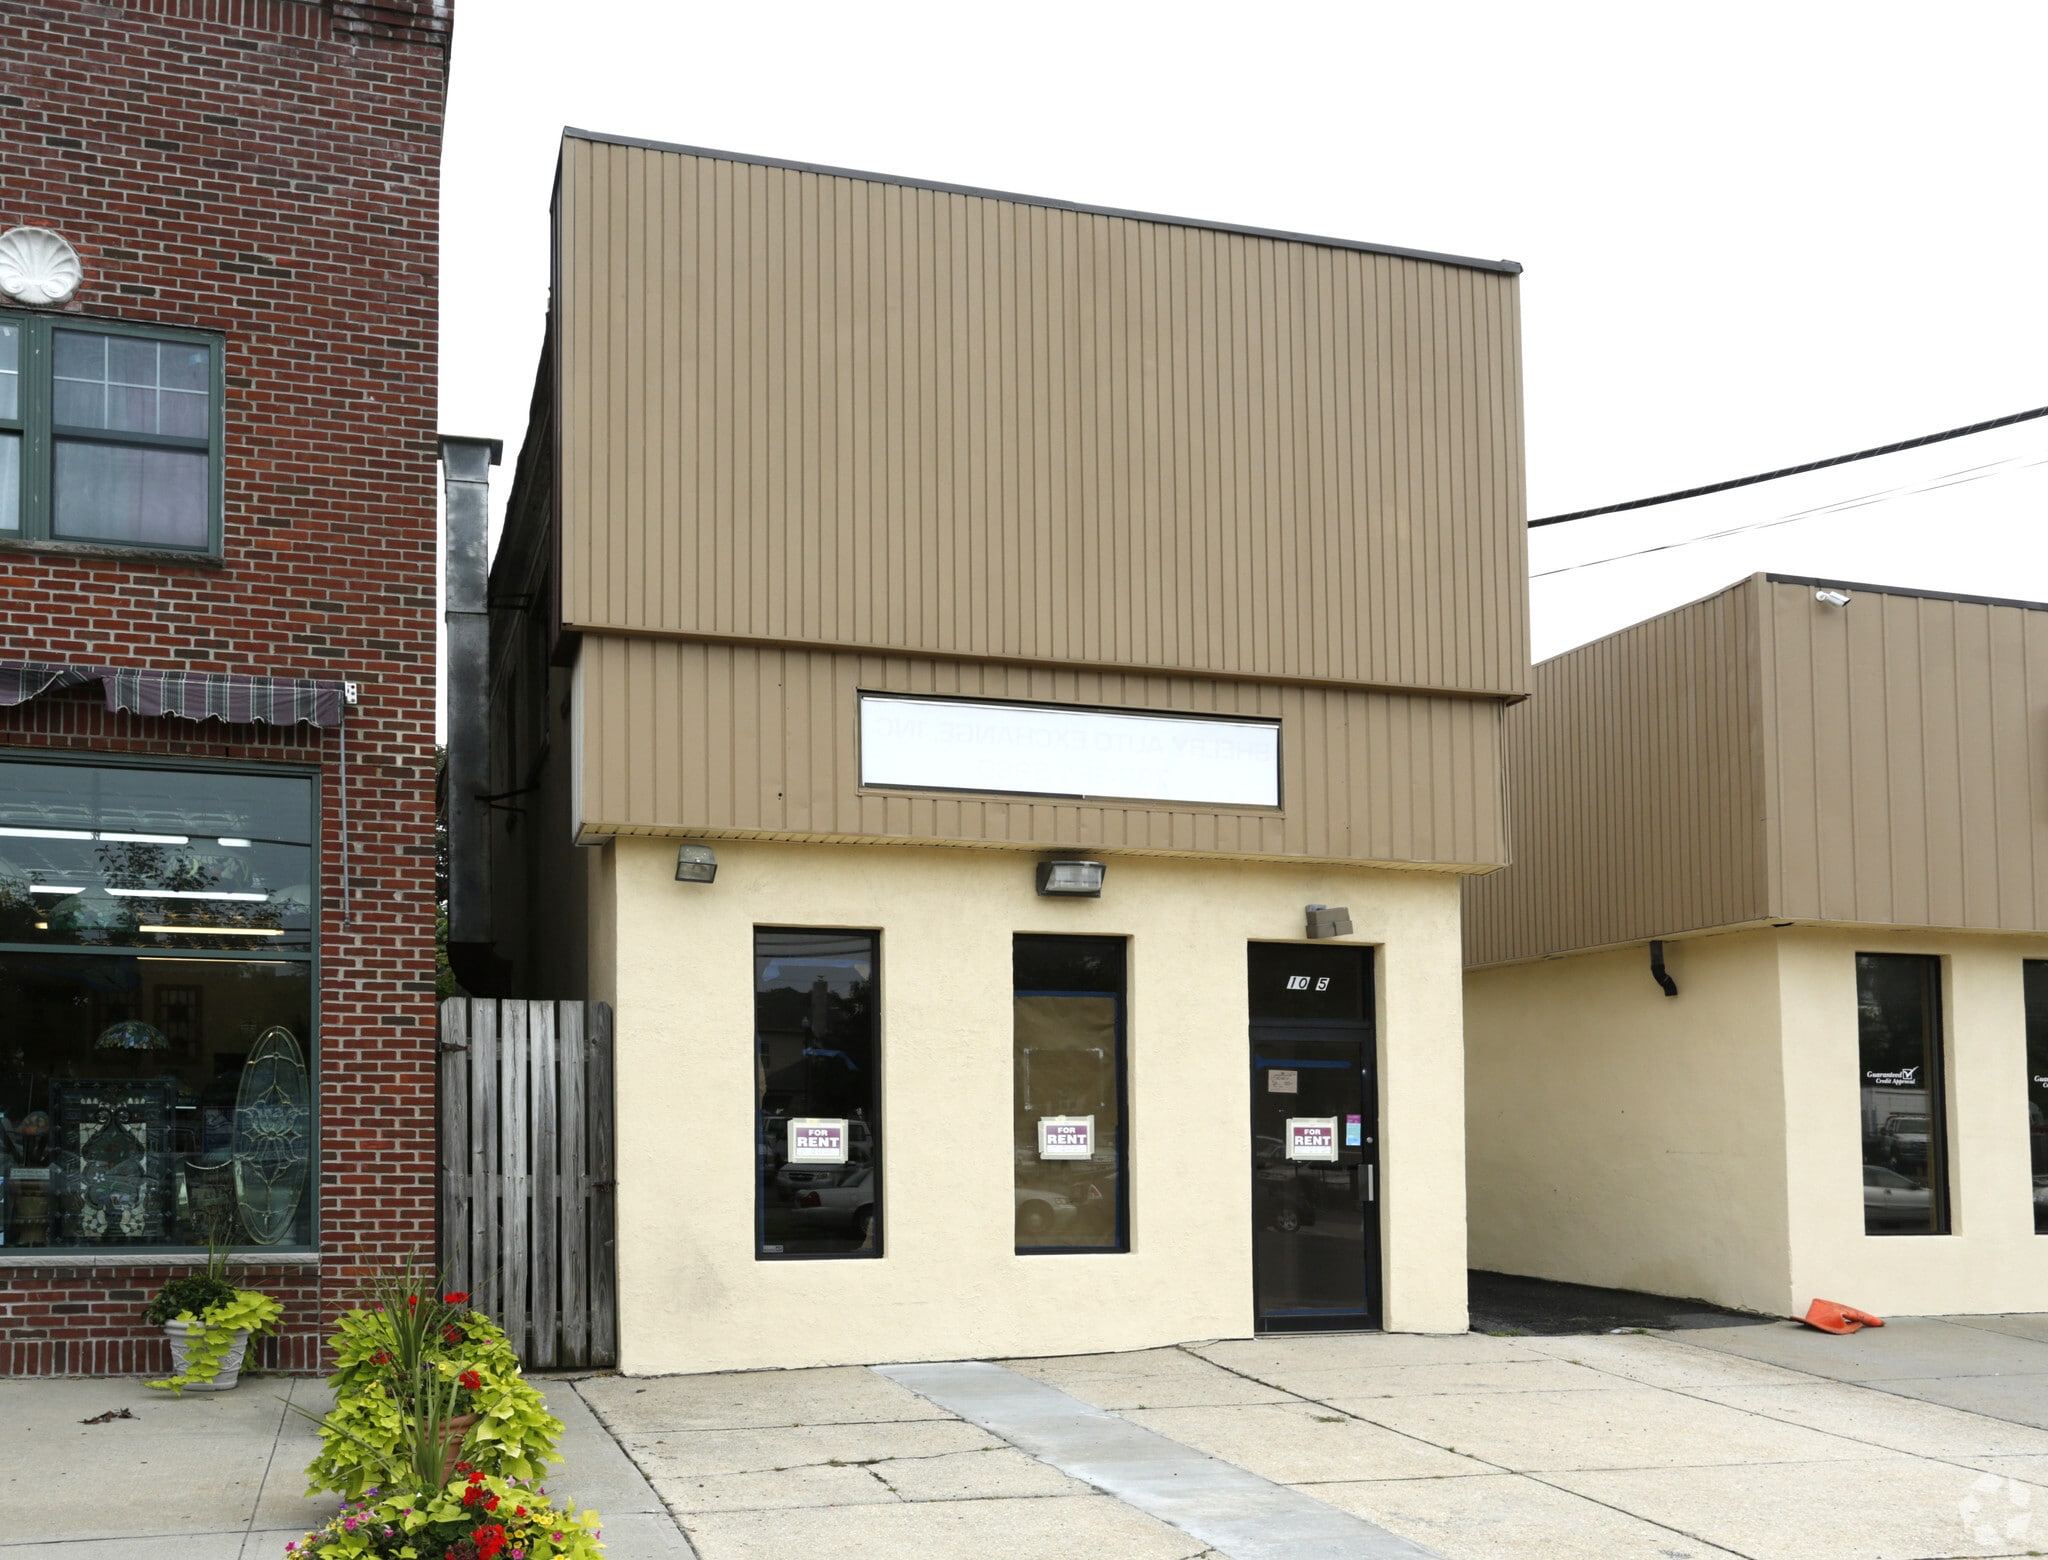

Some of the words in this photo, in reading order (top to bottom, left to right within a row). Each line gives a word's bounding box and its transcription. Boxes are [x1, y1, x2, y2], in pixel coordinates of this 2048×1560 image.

[797, 1137, 840, 1147] RENT
[1047, 1134, 1087, 1145] RENT
[1294, 1135, 1331, 1146] RENT
